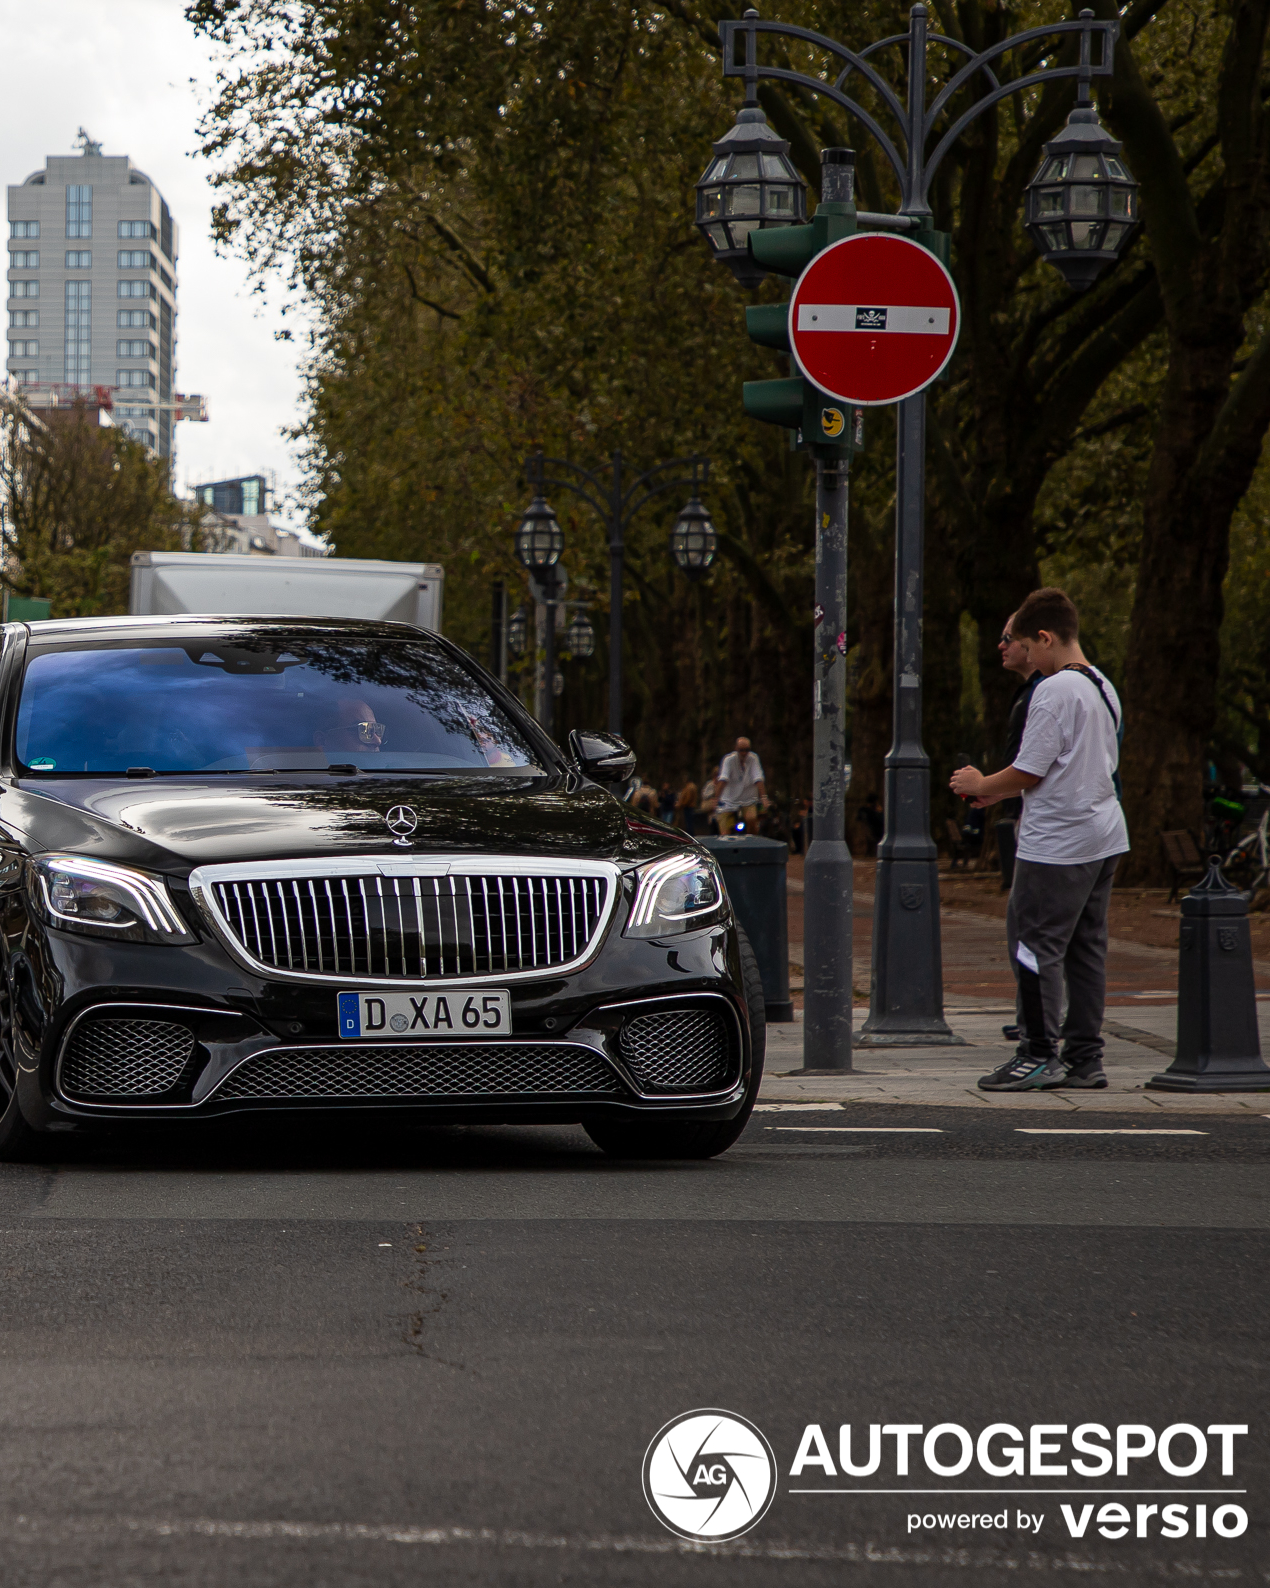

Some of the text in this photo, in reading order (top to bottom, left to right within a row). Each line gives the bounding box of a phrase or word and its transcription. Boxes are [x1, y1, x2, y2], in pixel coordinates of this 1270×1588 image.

[346, 1019, 355, 1029] D
[364, 996, 502, 1031] D XA 65
